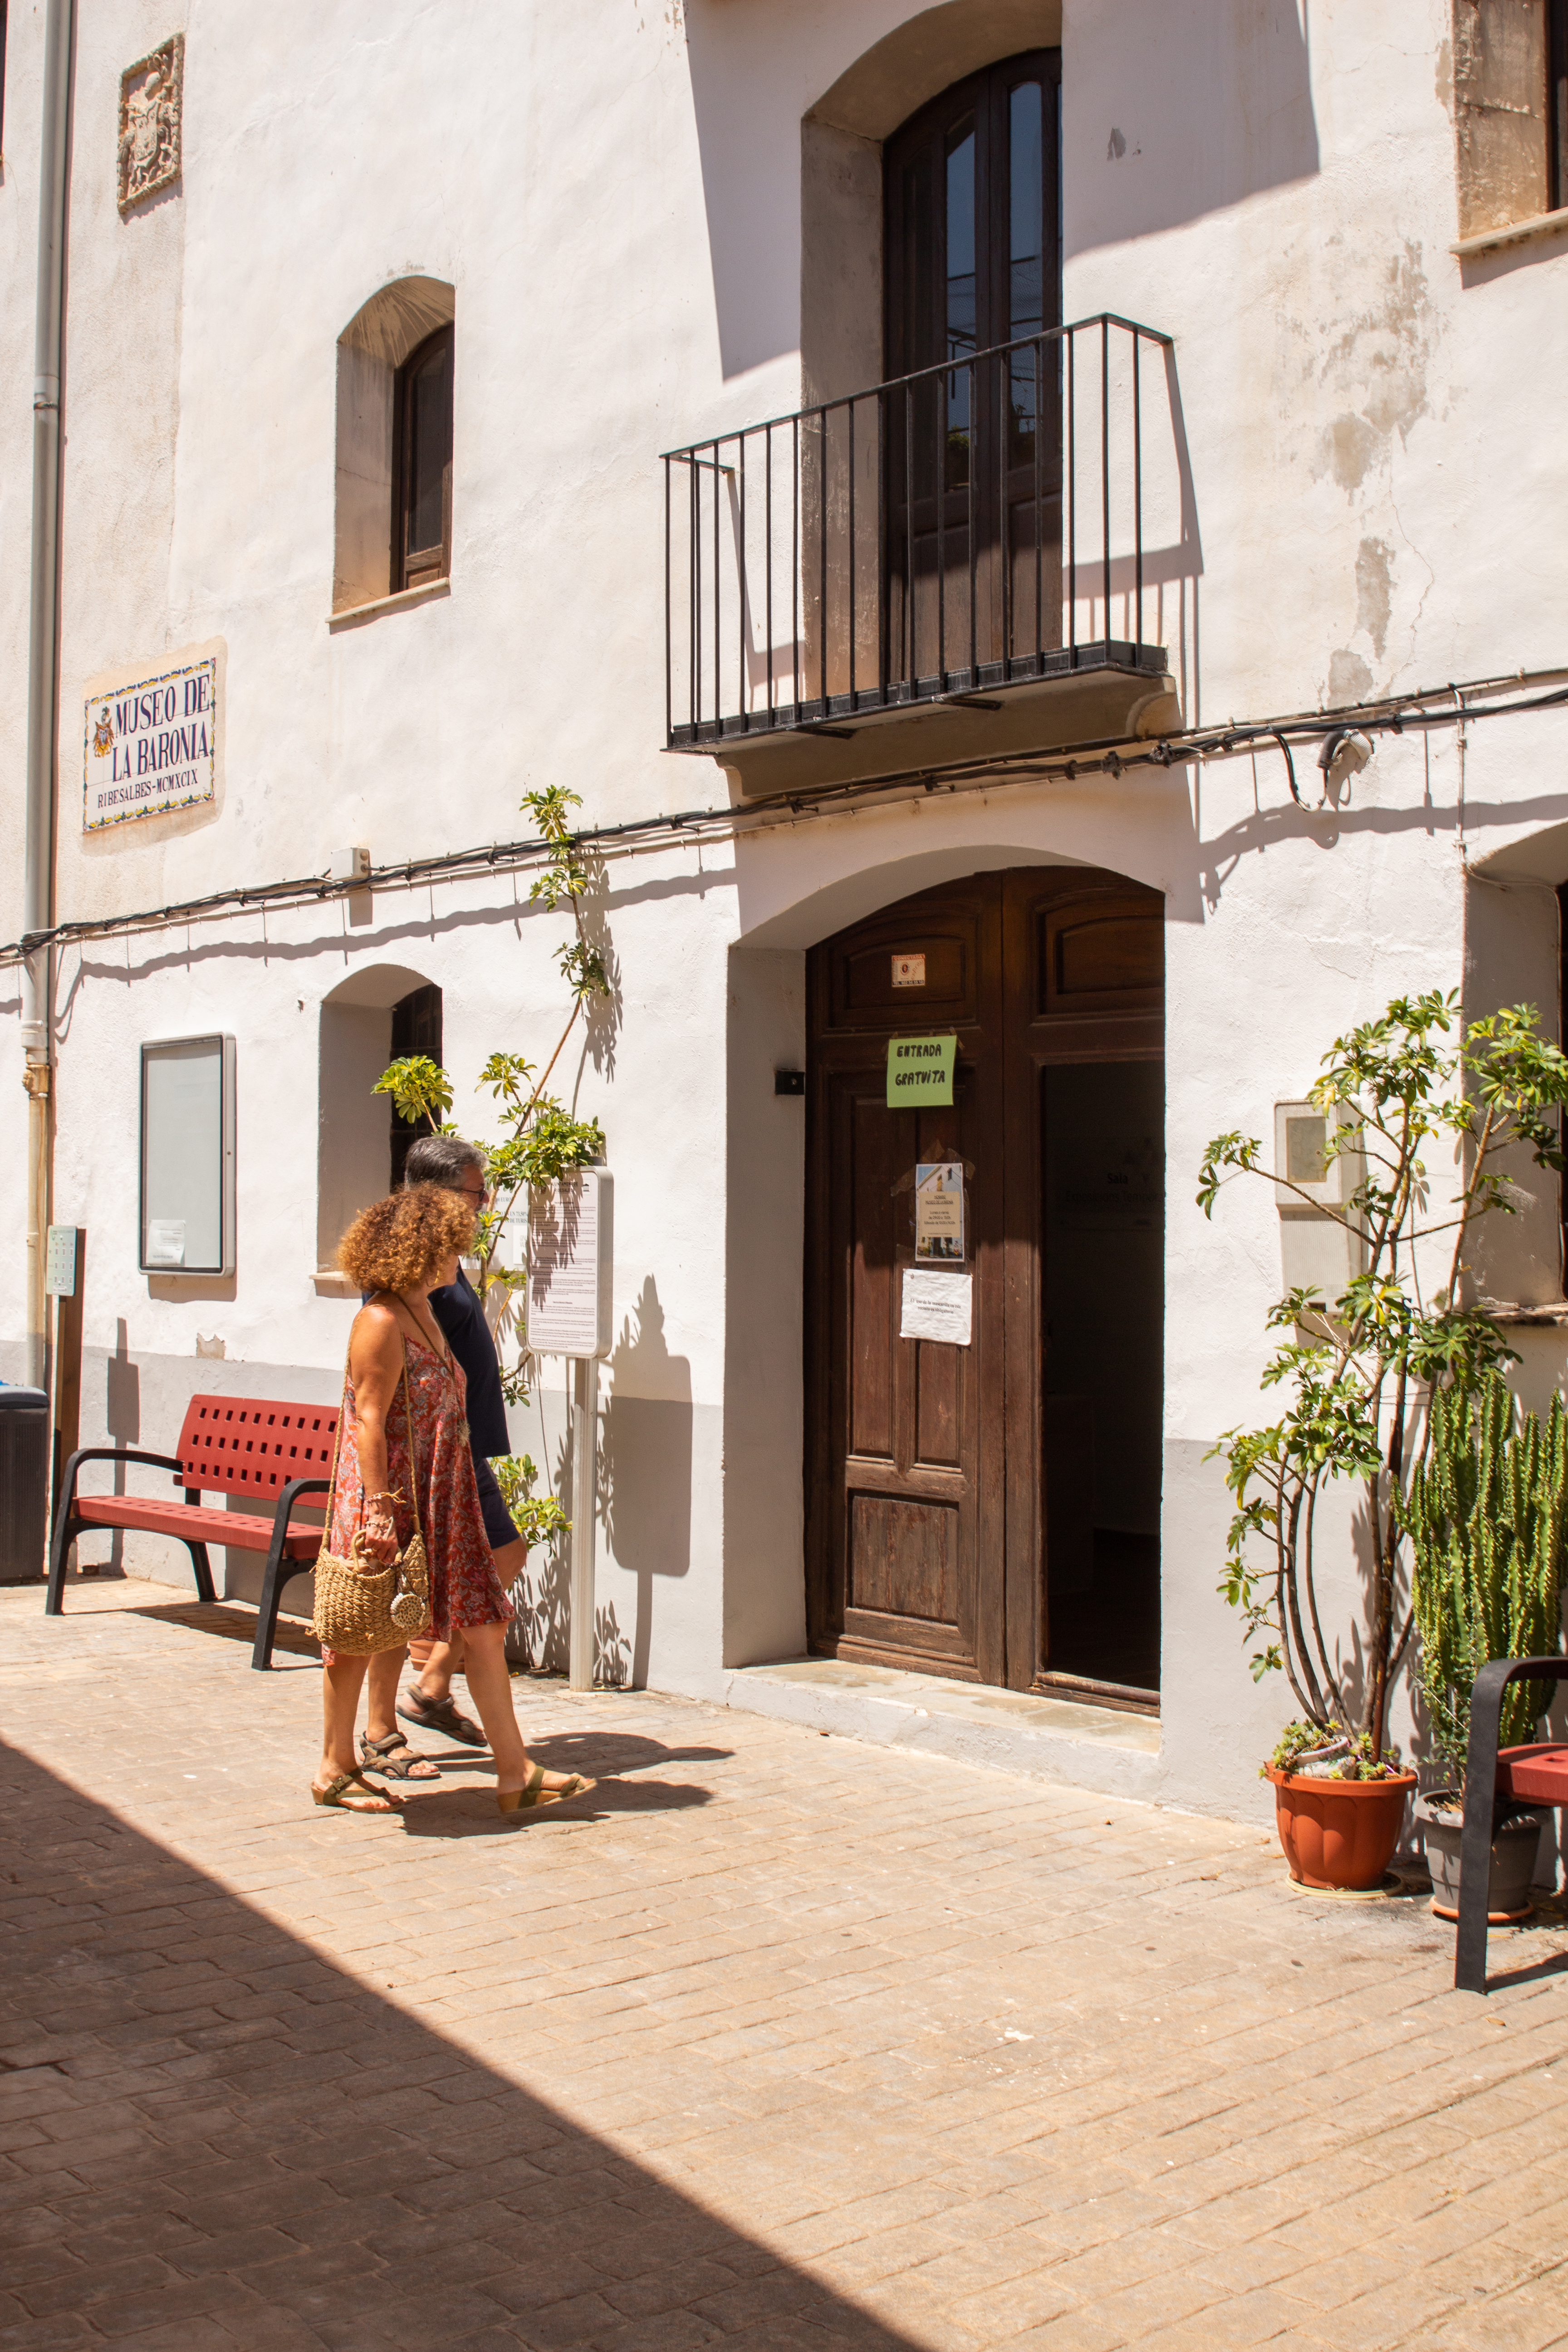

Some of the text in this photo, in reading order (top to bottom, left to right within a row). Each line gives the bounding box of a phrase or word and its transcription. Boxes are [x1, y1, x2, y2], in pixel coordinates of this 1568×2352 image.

[116, 674, 210, 738] MUSEO DE
[112, 721, 209, 782] LA BARONIA
[897, 1044, 941, 1058] ENTRADA
[1107, 1172, 1128, 1184] Sala
